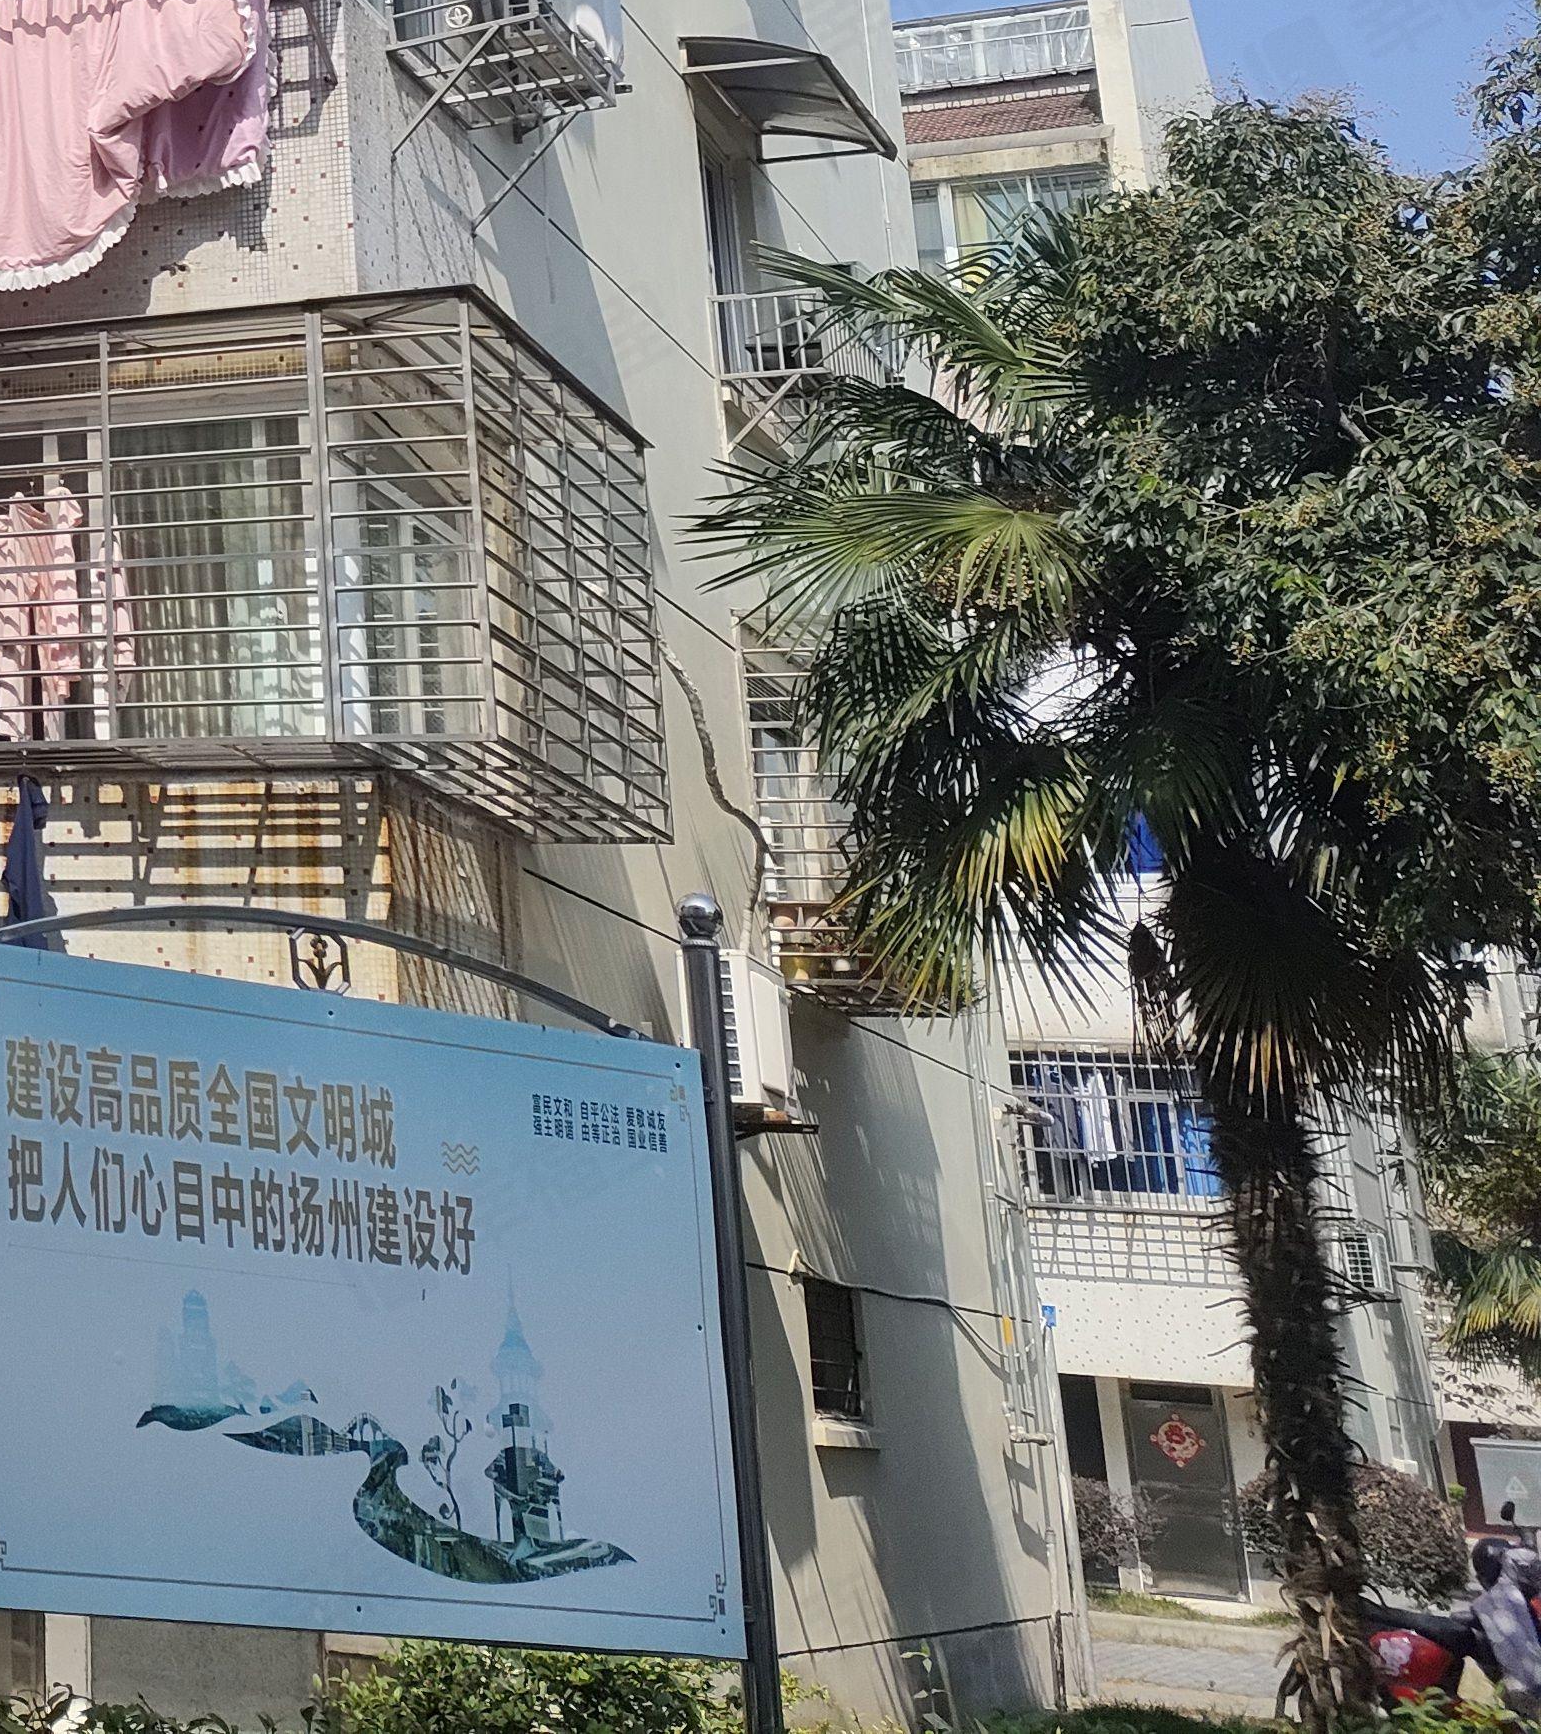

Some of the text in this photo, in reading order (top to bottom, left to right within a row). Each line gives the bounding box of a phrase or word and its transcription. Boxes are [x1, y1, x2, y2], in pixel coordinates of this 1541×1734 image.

[5, 1035, 397, 1170] 建设高品质全国文明城
[7, 1134, 476, 1276] 把人们心目中的扬州建设好
